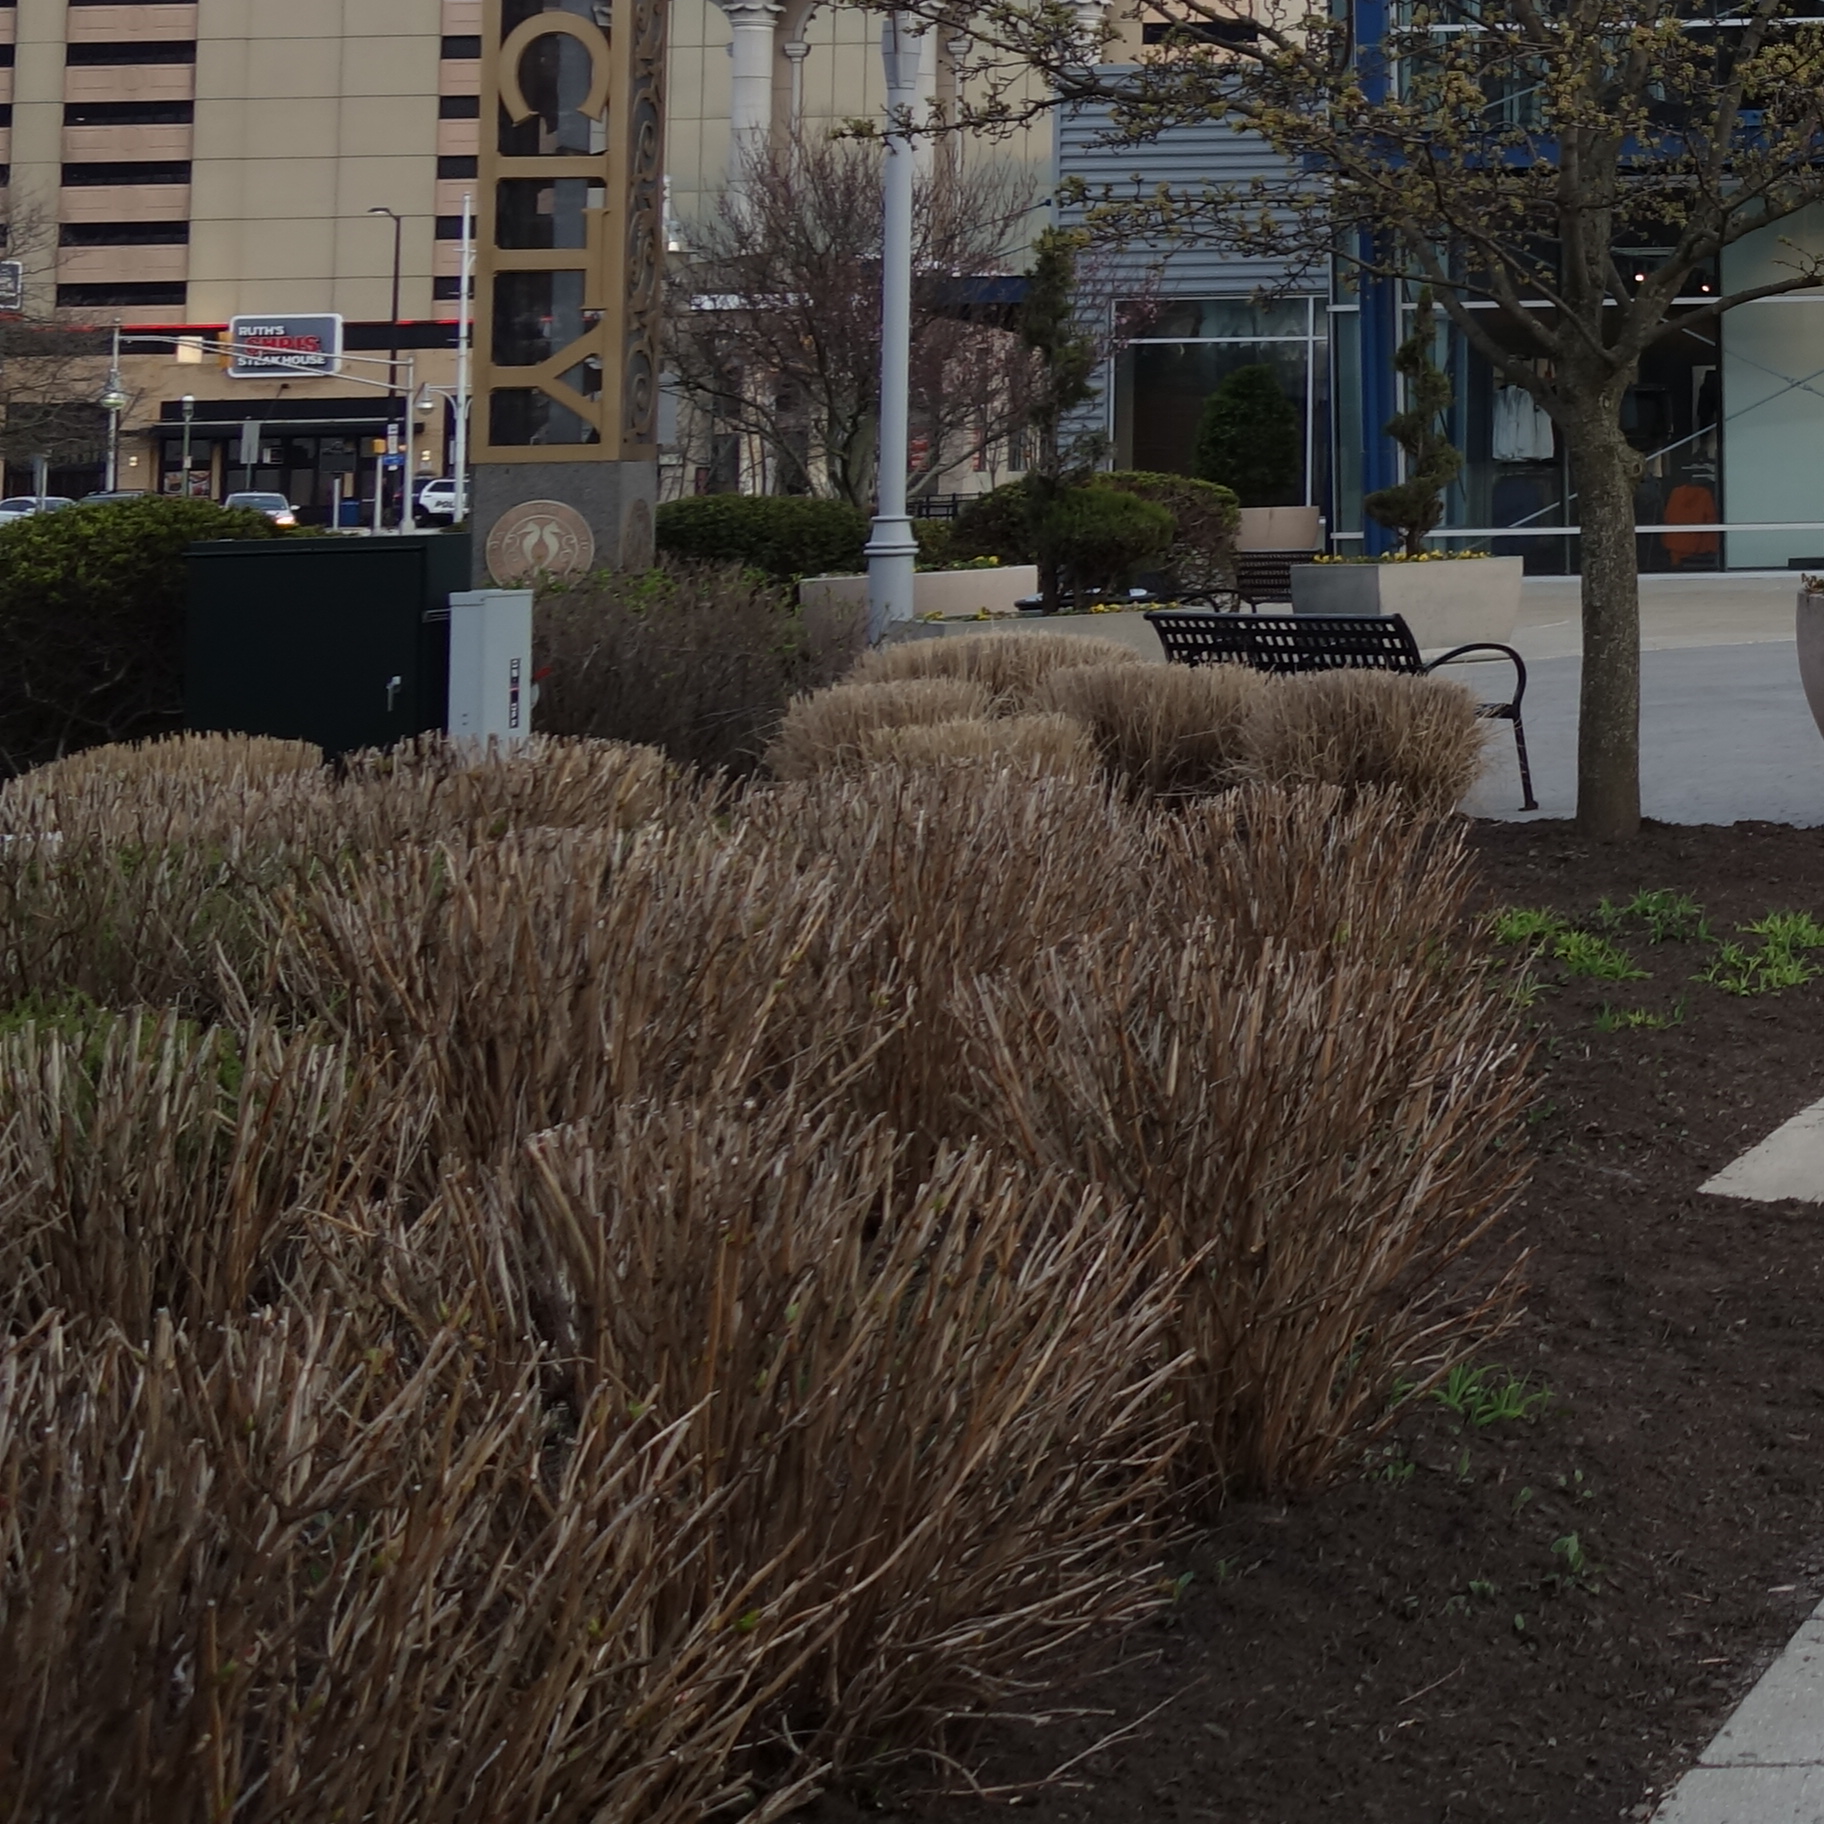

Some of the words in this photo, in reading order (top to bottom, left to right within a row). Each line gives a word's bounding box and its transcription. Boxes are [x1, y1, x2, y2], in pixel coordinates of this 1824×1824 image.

[489, 11, 612, 442] CITY
[238, 325, 286, 336] RUTH'S
[246, 335, 321, 355] CHRIS
[281, 354, 326, 366] HOUSE
